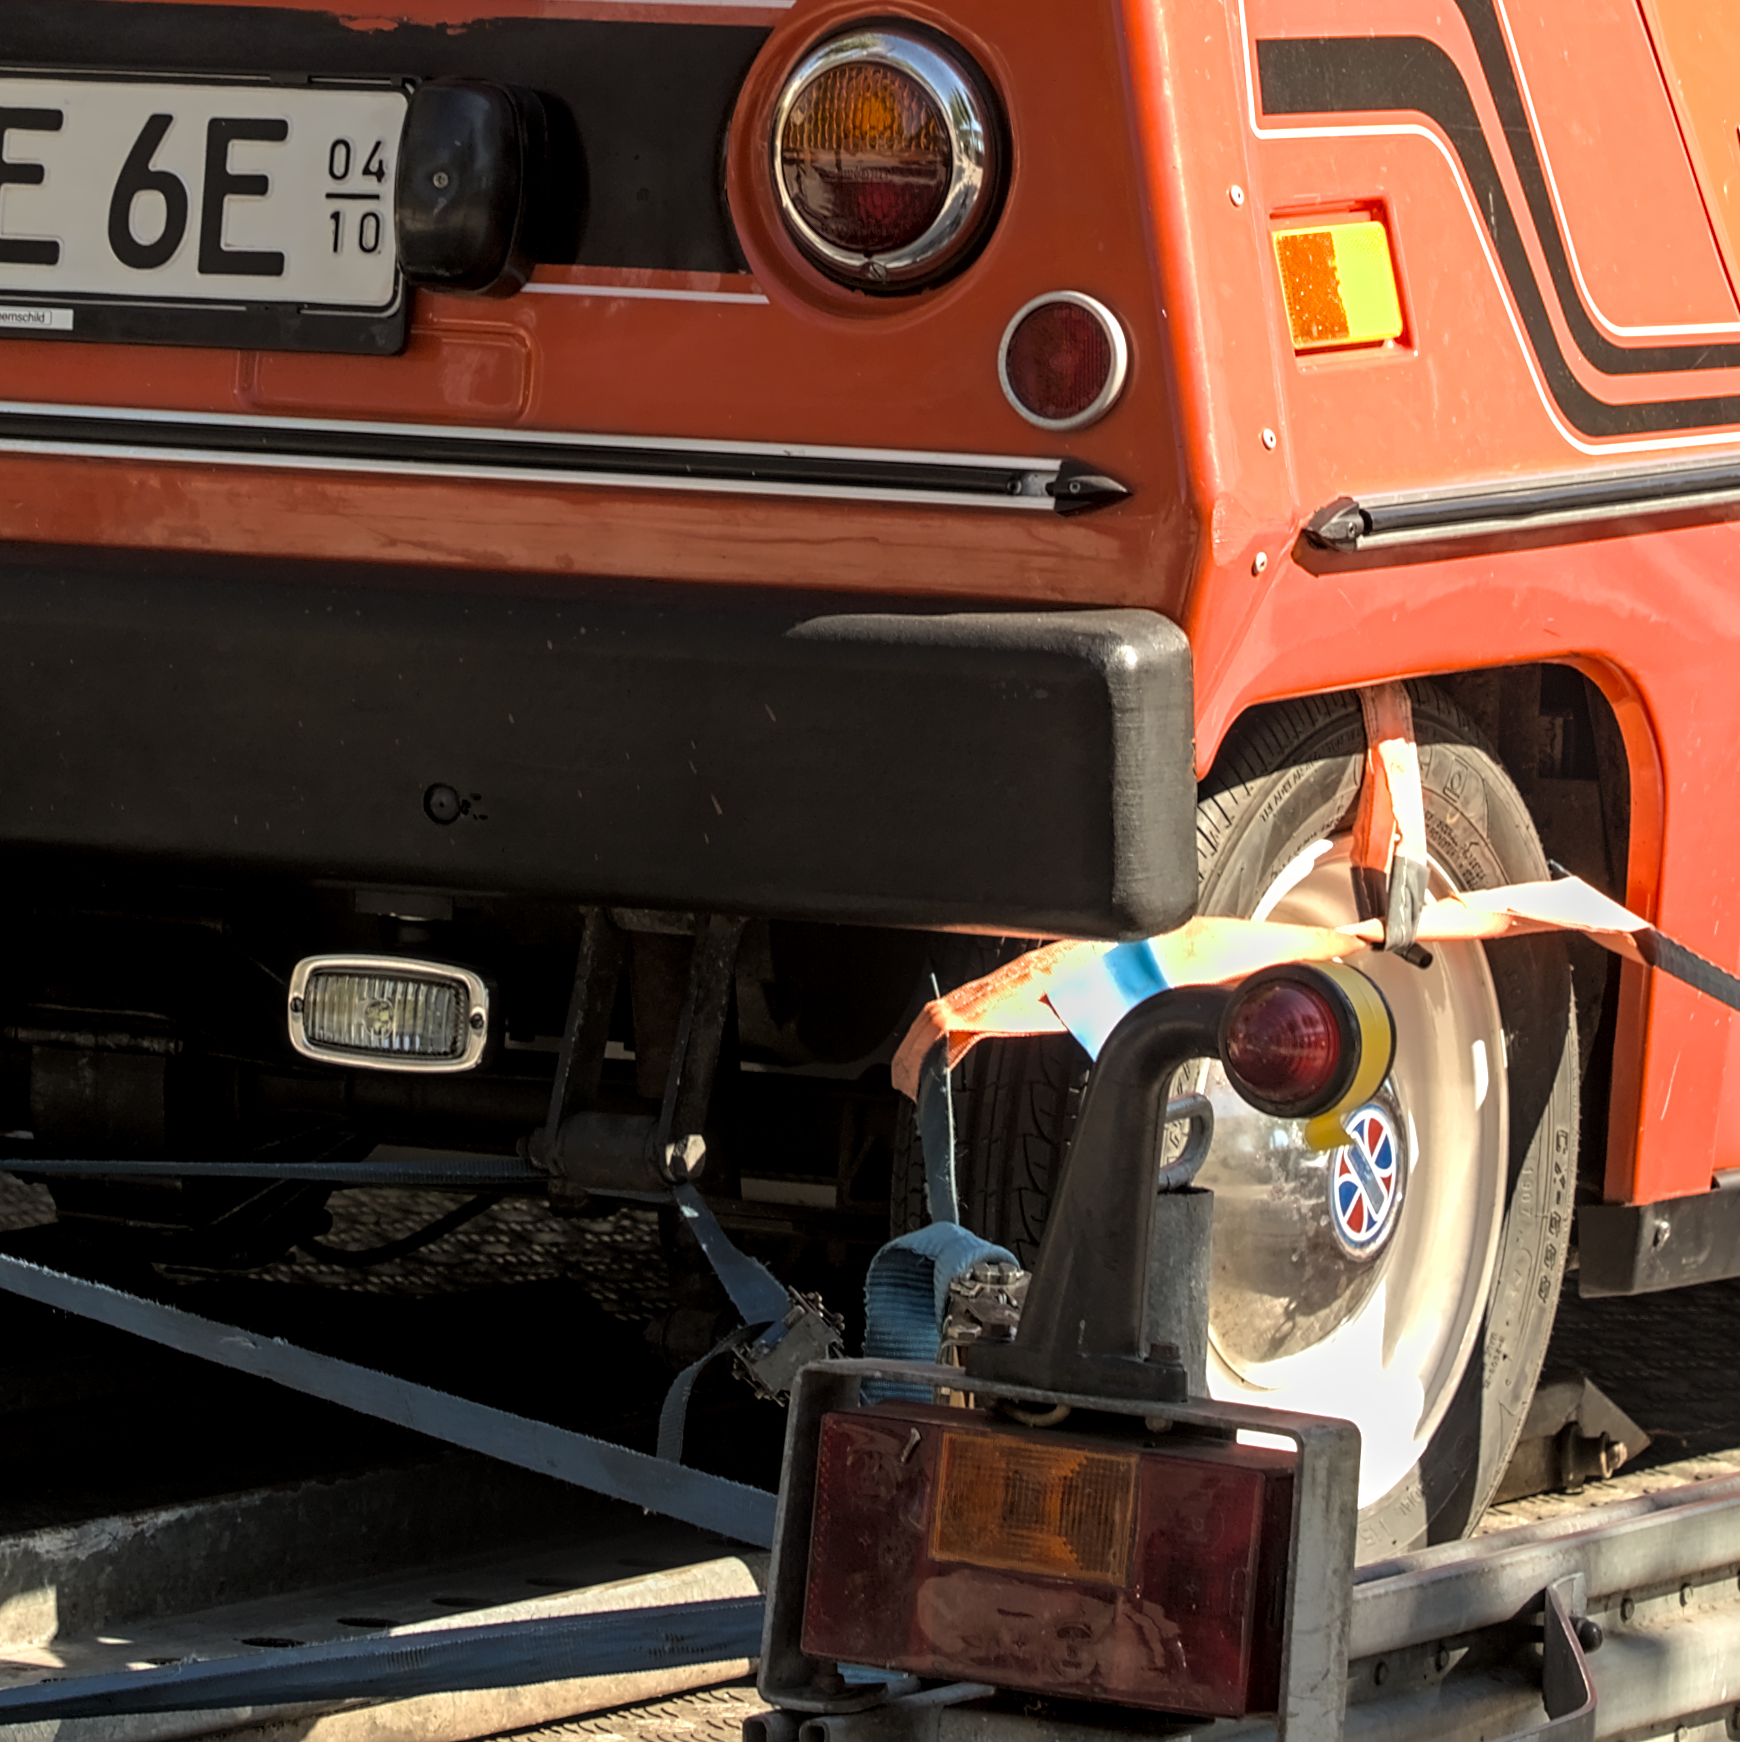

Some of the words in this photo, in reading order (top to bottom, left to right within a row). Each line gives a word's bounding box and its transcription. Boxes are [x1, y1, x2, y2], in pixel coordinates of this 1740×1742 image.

[328, 138, 386, 182] 04
[108, 113, 289, 276] 6E
[329, 210, 381, 254] 10
